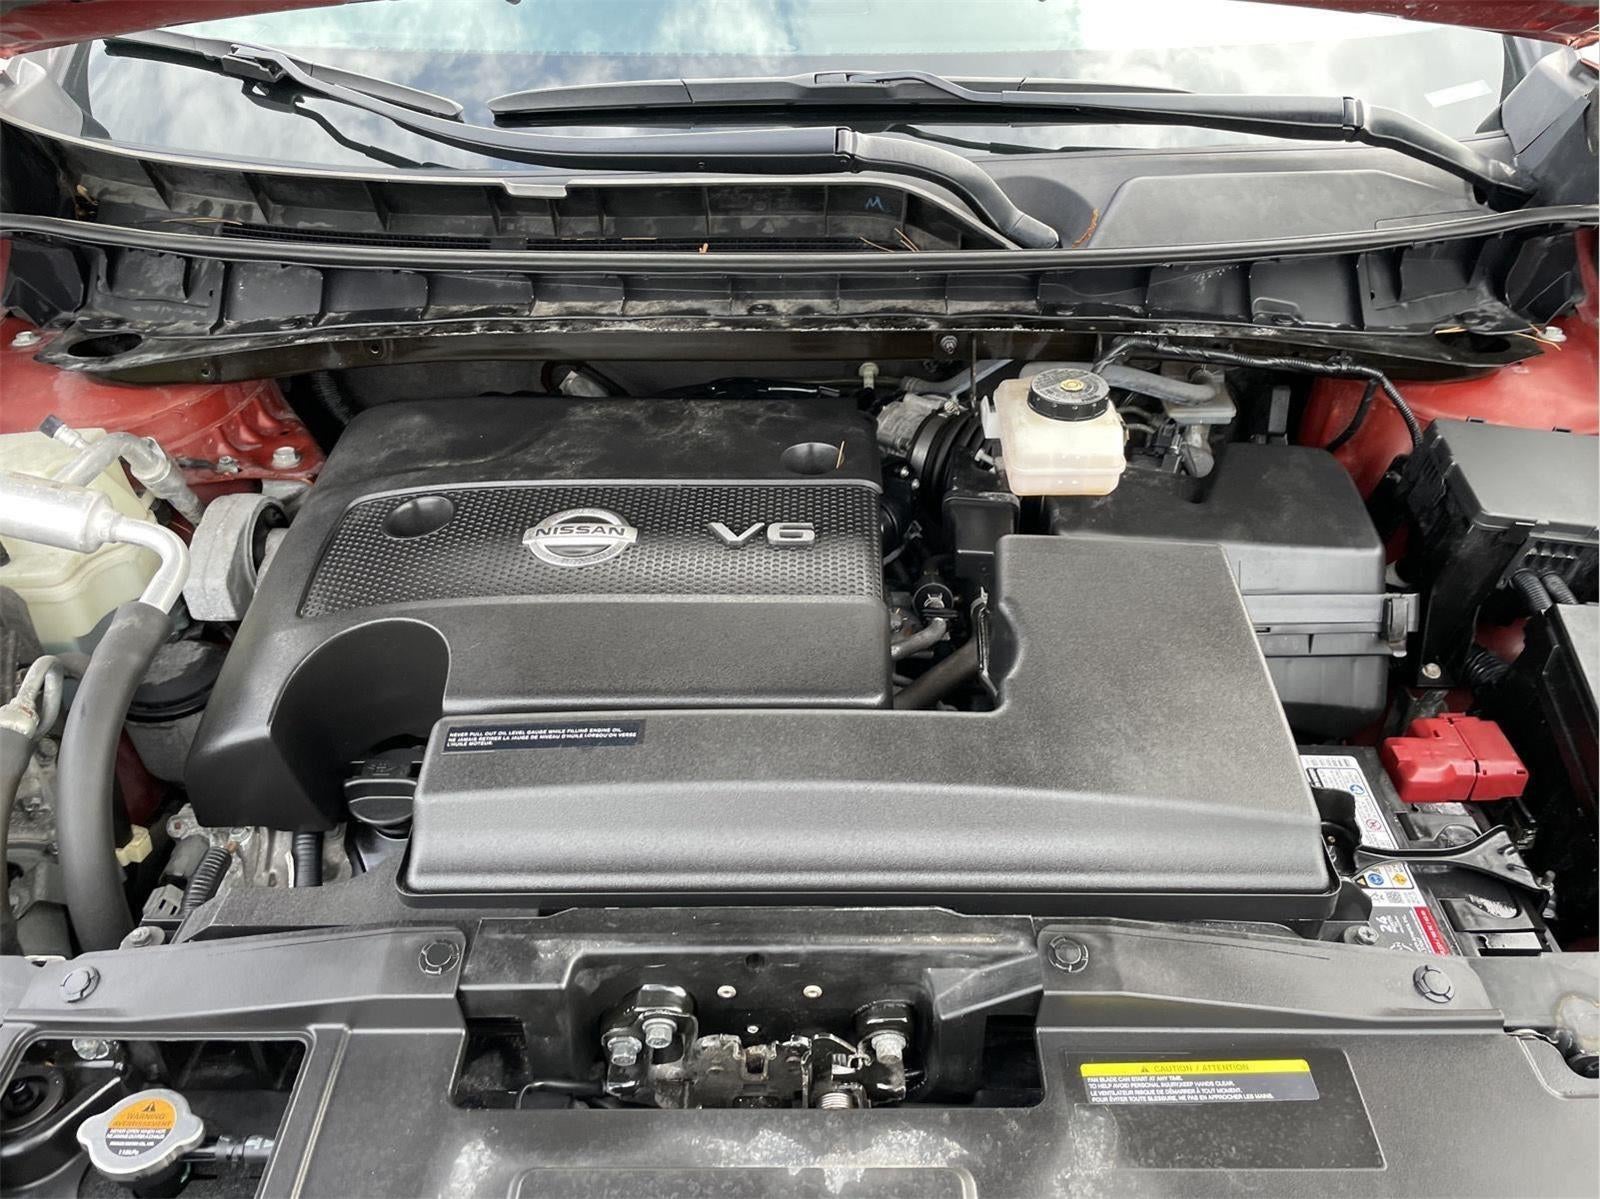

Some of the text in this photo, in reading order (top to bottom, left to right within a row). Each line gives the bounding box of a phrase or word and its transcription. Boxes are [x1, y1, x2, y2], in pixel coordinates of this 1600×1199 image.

[534, 524, 626, 536] NISSAN
[707, 522, 816, 546] V6
[1202, 1064, 1250, 1072] ATTENTION
